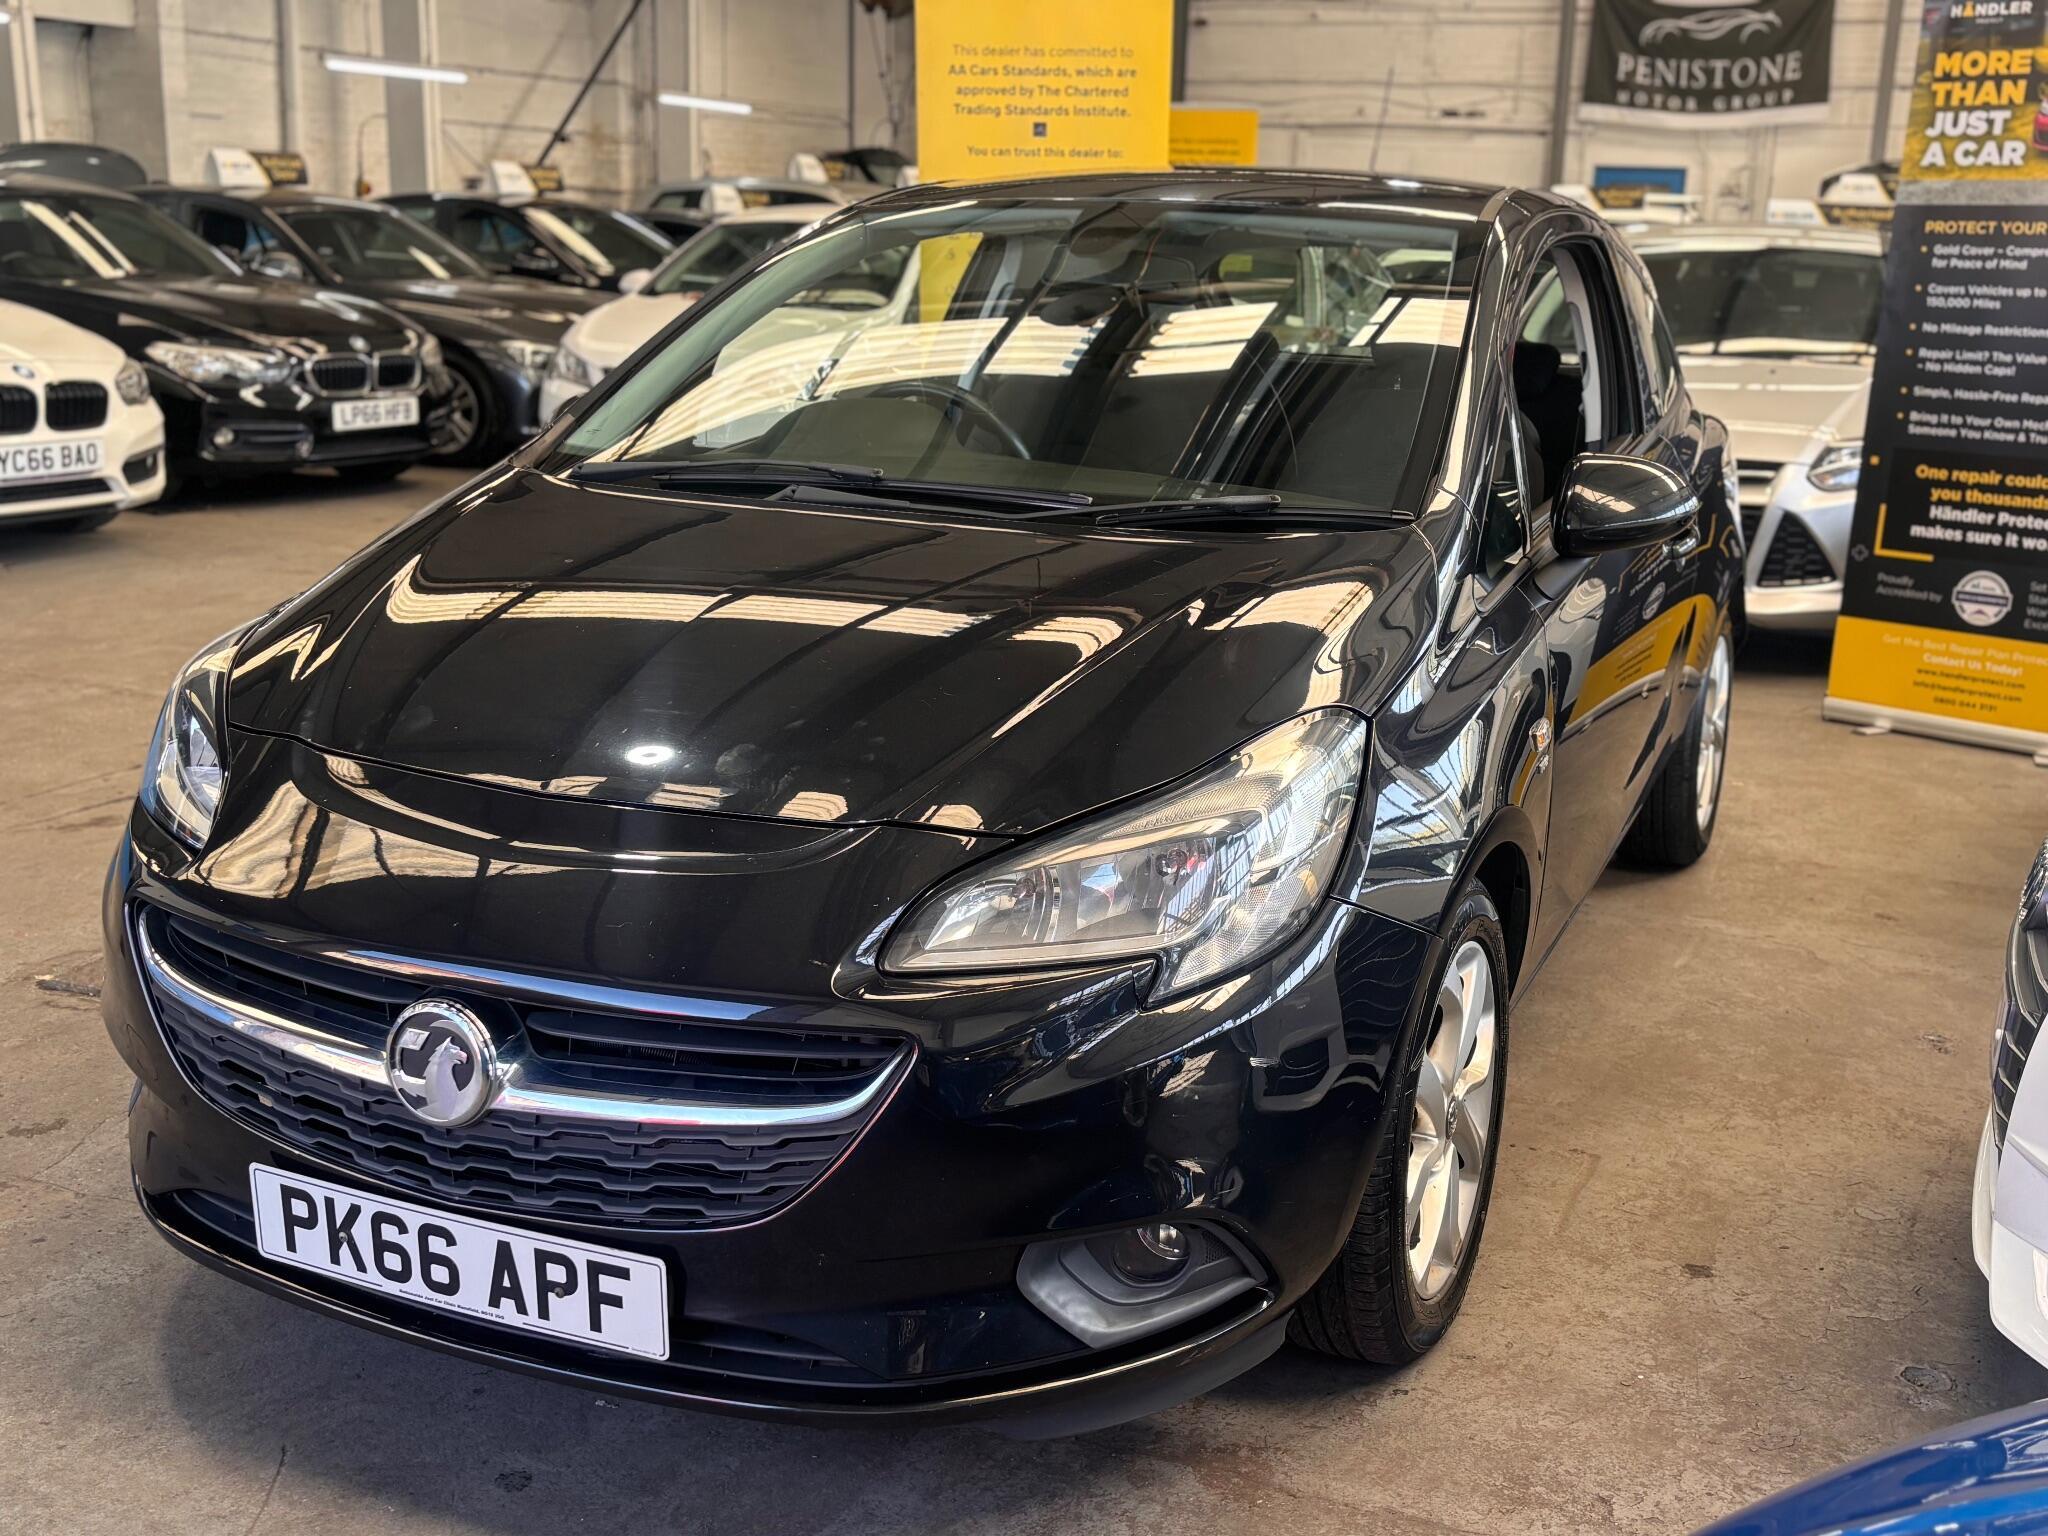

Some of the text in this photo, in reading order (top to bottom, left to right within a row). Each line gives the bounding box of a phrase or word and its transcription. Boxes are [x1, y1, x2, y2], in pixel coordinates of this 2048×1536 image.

[953, 45, 1135, 59] This dealer has committed to
[948, 64, 1138, 79] AA Cars Standards, which are
[1616, 51, 1803, 90] PENISTONE
[1933, 49, 2034, 78] MORE
[956, 84, 1130, 98] approved by The Chartered
[1615, 86, 1795, 112] MOTOR GROUP
[1931, 79, 2029, 107] THAN
[954, 103, 1132, 118] Trading Standards Institute.
[1924, 109, 2013, 138] JUST
[967, 146, 989, 157] You
[991, 147, 1012, 157] can
[1014, 146, 1041, 158] trust
[1044, 146, 1066, 158] this
[1068, 147, 1105, 158] dealer
[1919, 139, 2027, 168] A CAR
[1924, 220, 2048, 236] PROTECT YOUR
[1932, 243, 1961, 256] Gold
[1961, 244, 1996, 257] Cover
[1931, 257, 2029, 271] for Peace of Mind
[1927, 282, 2048, 299] Covers Vehicles up to
[1972, 297, 2002, 310] Miles
[1921, 321, 1939, 334] No
[1940, 322, 1983, 337] Mileage
[1918, 347, 1954, 361] Repair
[1991, 350, 2014, 363] The
[2015, 351, 2048, 365] Value
[1924, 361, 1942, 373] No
[1942, 361, 1983, 374] Hidden
[1909, 410, 1939, 425] Bring
[1950, 414, 1964, 426] to
[1965, 414, 1993, 427] Your
[1993, 416, 2021, 429] Own
[1907, 423, 1958, 438] Someone
[1959, 427, 1982, 440] You
[1982, 428, 2017, 442] Know
[0, 442, 99, 475] YC66 BAO
[1915, 463, 1950, 481] One
[1951, 468, 2002, 486] repair
[1929, 487, 1963, 503] you
[1909, 524, 1963, 543] makes
[1965, 531, 2003, 548] sure
[2005, 531, 2020, 548] it
[1923, 652, 1965, 668] Contact
[1967, 659, 1982, 671] Us
[279, 1183, 632, 1334] PK66 APF
